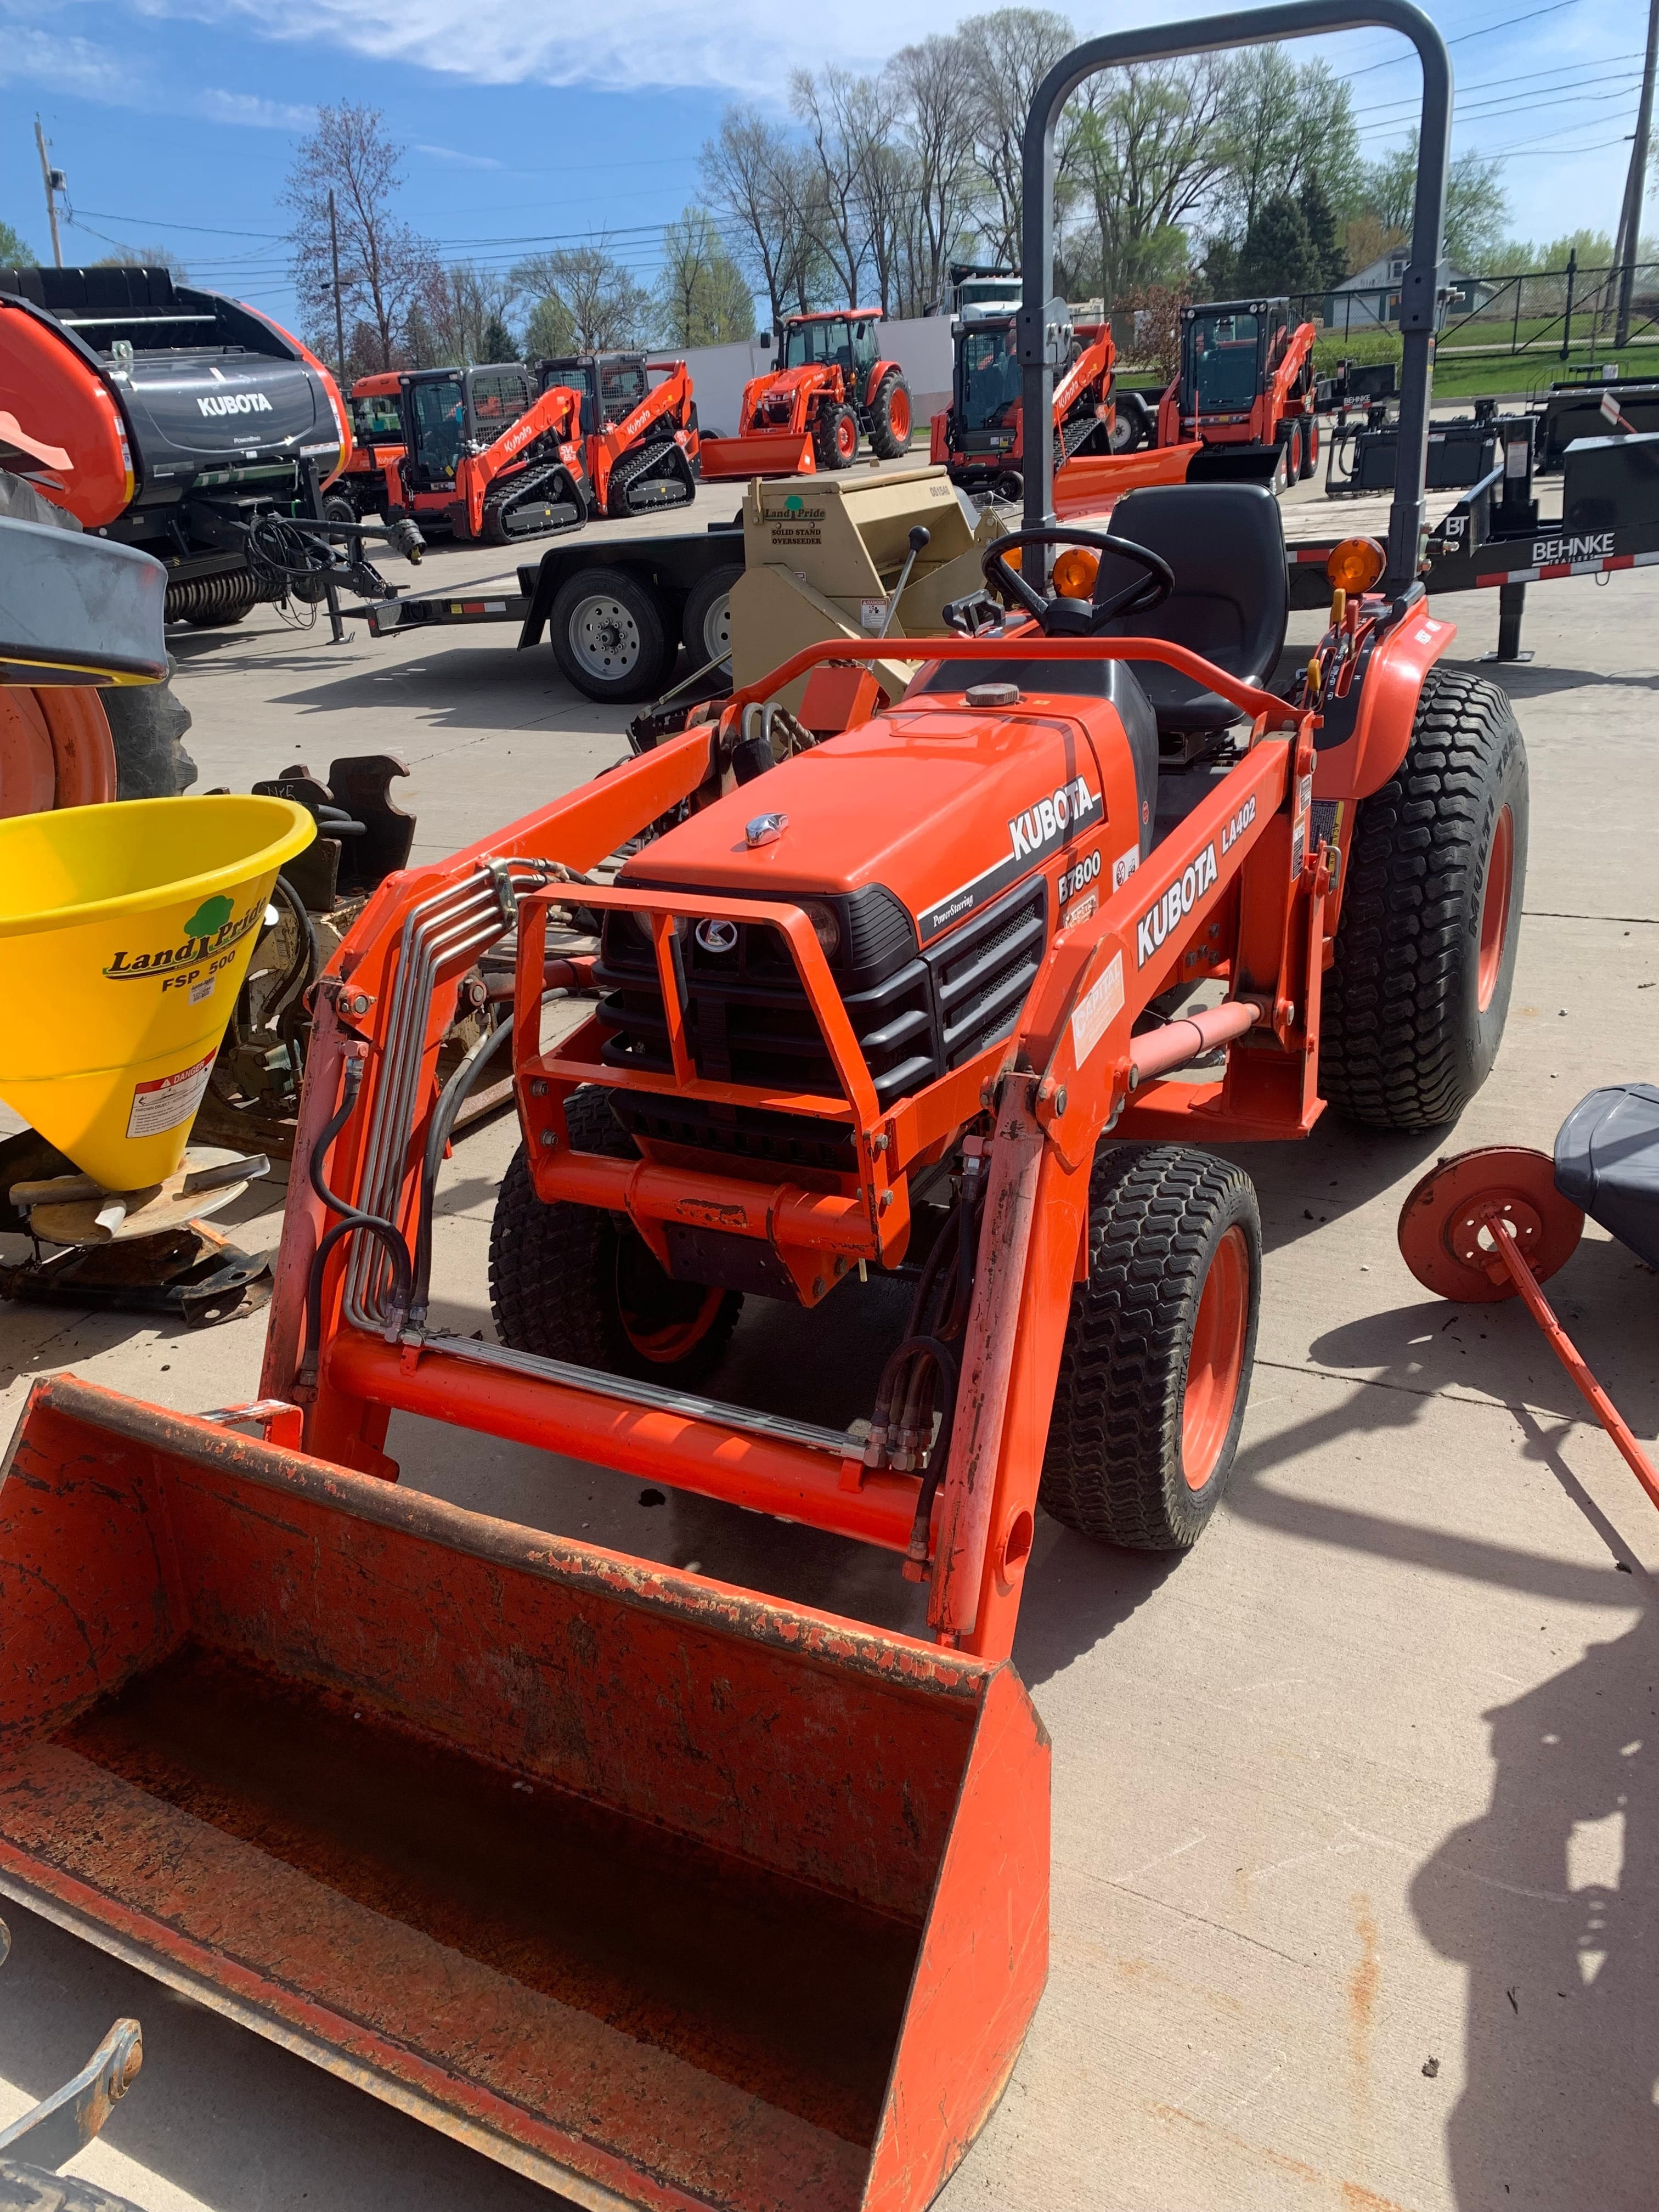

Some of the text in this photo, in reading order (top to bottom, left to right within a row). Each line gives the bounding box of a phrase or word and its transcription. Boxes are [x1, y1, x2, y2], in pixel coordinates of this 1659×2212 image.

[197, 393, 273, 417] KUBOTA
[1344, 394, 1371, 404] BEHNKE
[627, 410, 651, 436] Kubota
[504, 425, 532, 453] Kubota
[560, 445, 576, 454] SVL
[765, 509, 825, 518] Land Pride
[1446, 516, 1470, 537] BT
[1533, 532, 1616, 562] BEHNKE
[1549, 554, 1595, 565] TRAILERS
[1009, 776, 1093, 861] KUBOTA
[1221, 795, 1256, 856] LA402
[1330, 828, 1340, 865] CAUON
[1058, 850, 1101, 906] B7800
[1469, 793, 1494, 939] MULTI
[933, 894, 973, 928] PowerSteering
[1137, 841, 1217, 968] KUBOTA
[109, 896, 267, 972] Land Pride
[162, 969, 200, 992] FSP
[208, 950, 236, 974] 500
[173, 1060, 205, 1084] DANGER
